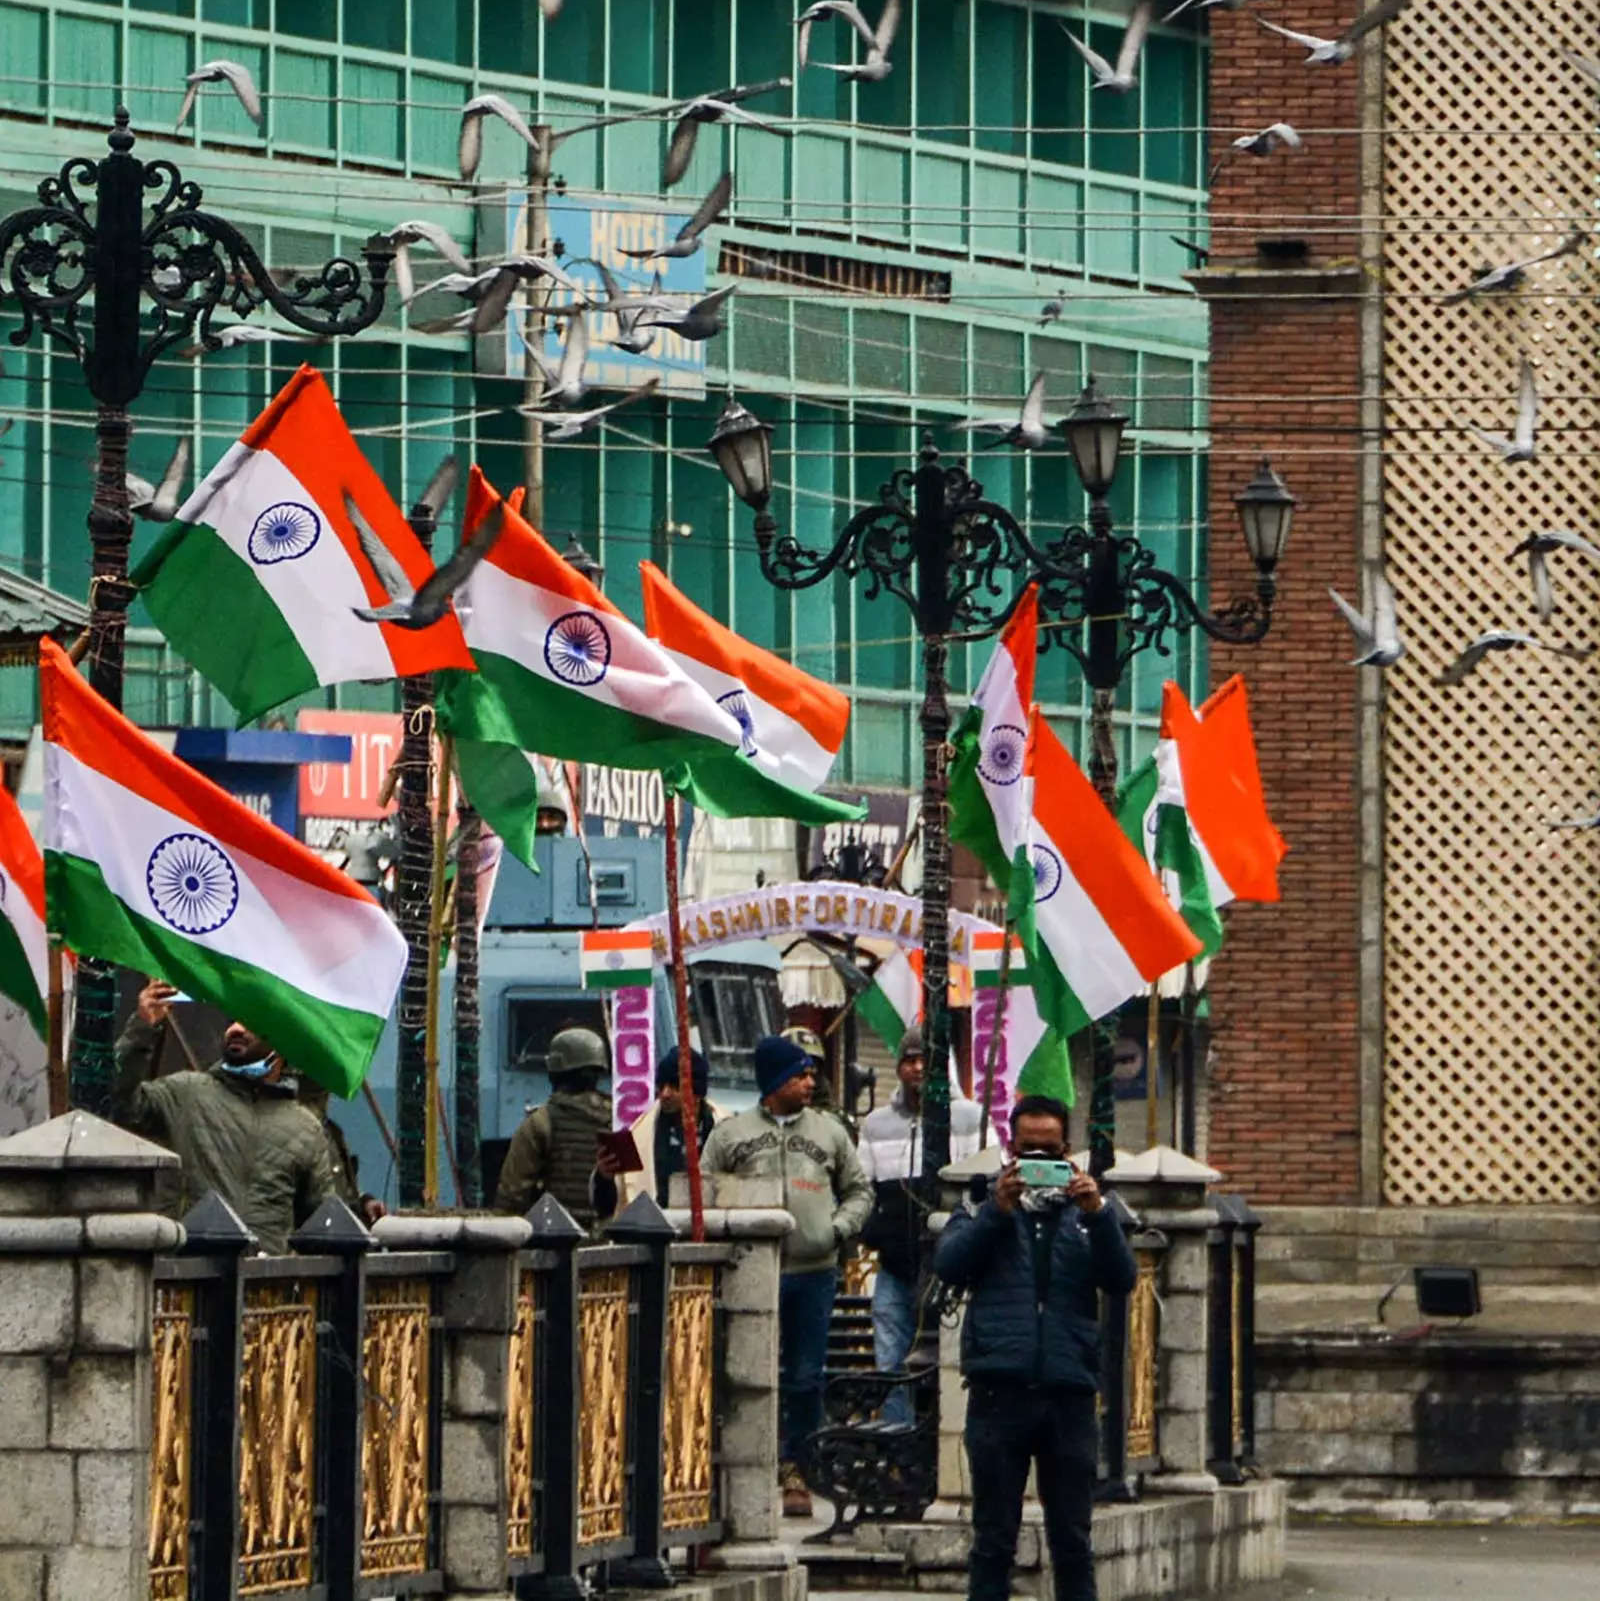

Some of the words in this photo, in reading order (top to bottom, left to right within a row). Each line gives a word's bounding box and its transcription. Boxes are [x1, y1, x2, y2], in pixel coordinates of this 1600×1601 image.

[590, 210, 668, 275] HOTEL
[584, 762, 680, 828] FASHIO
[651, 893, 965, 958] #KASHMIRFORTIRAA
